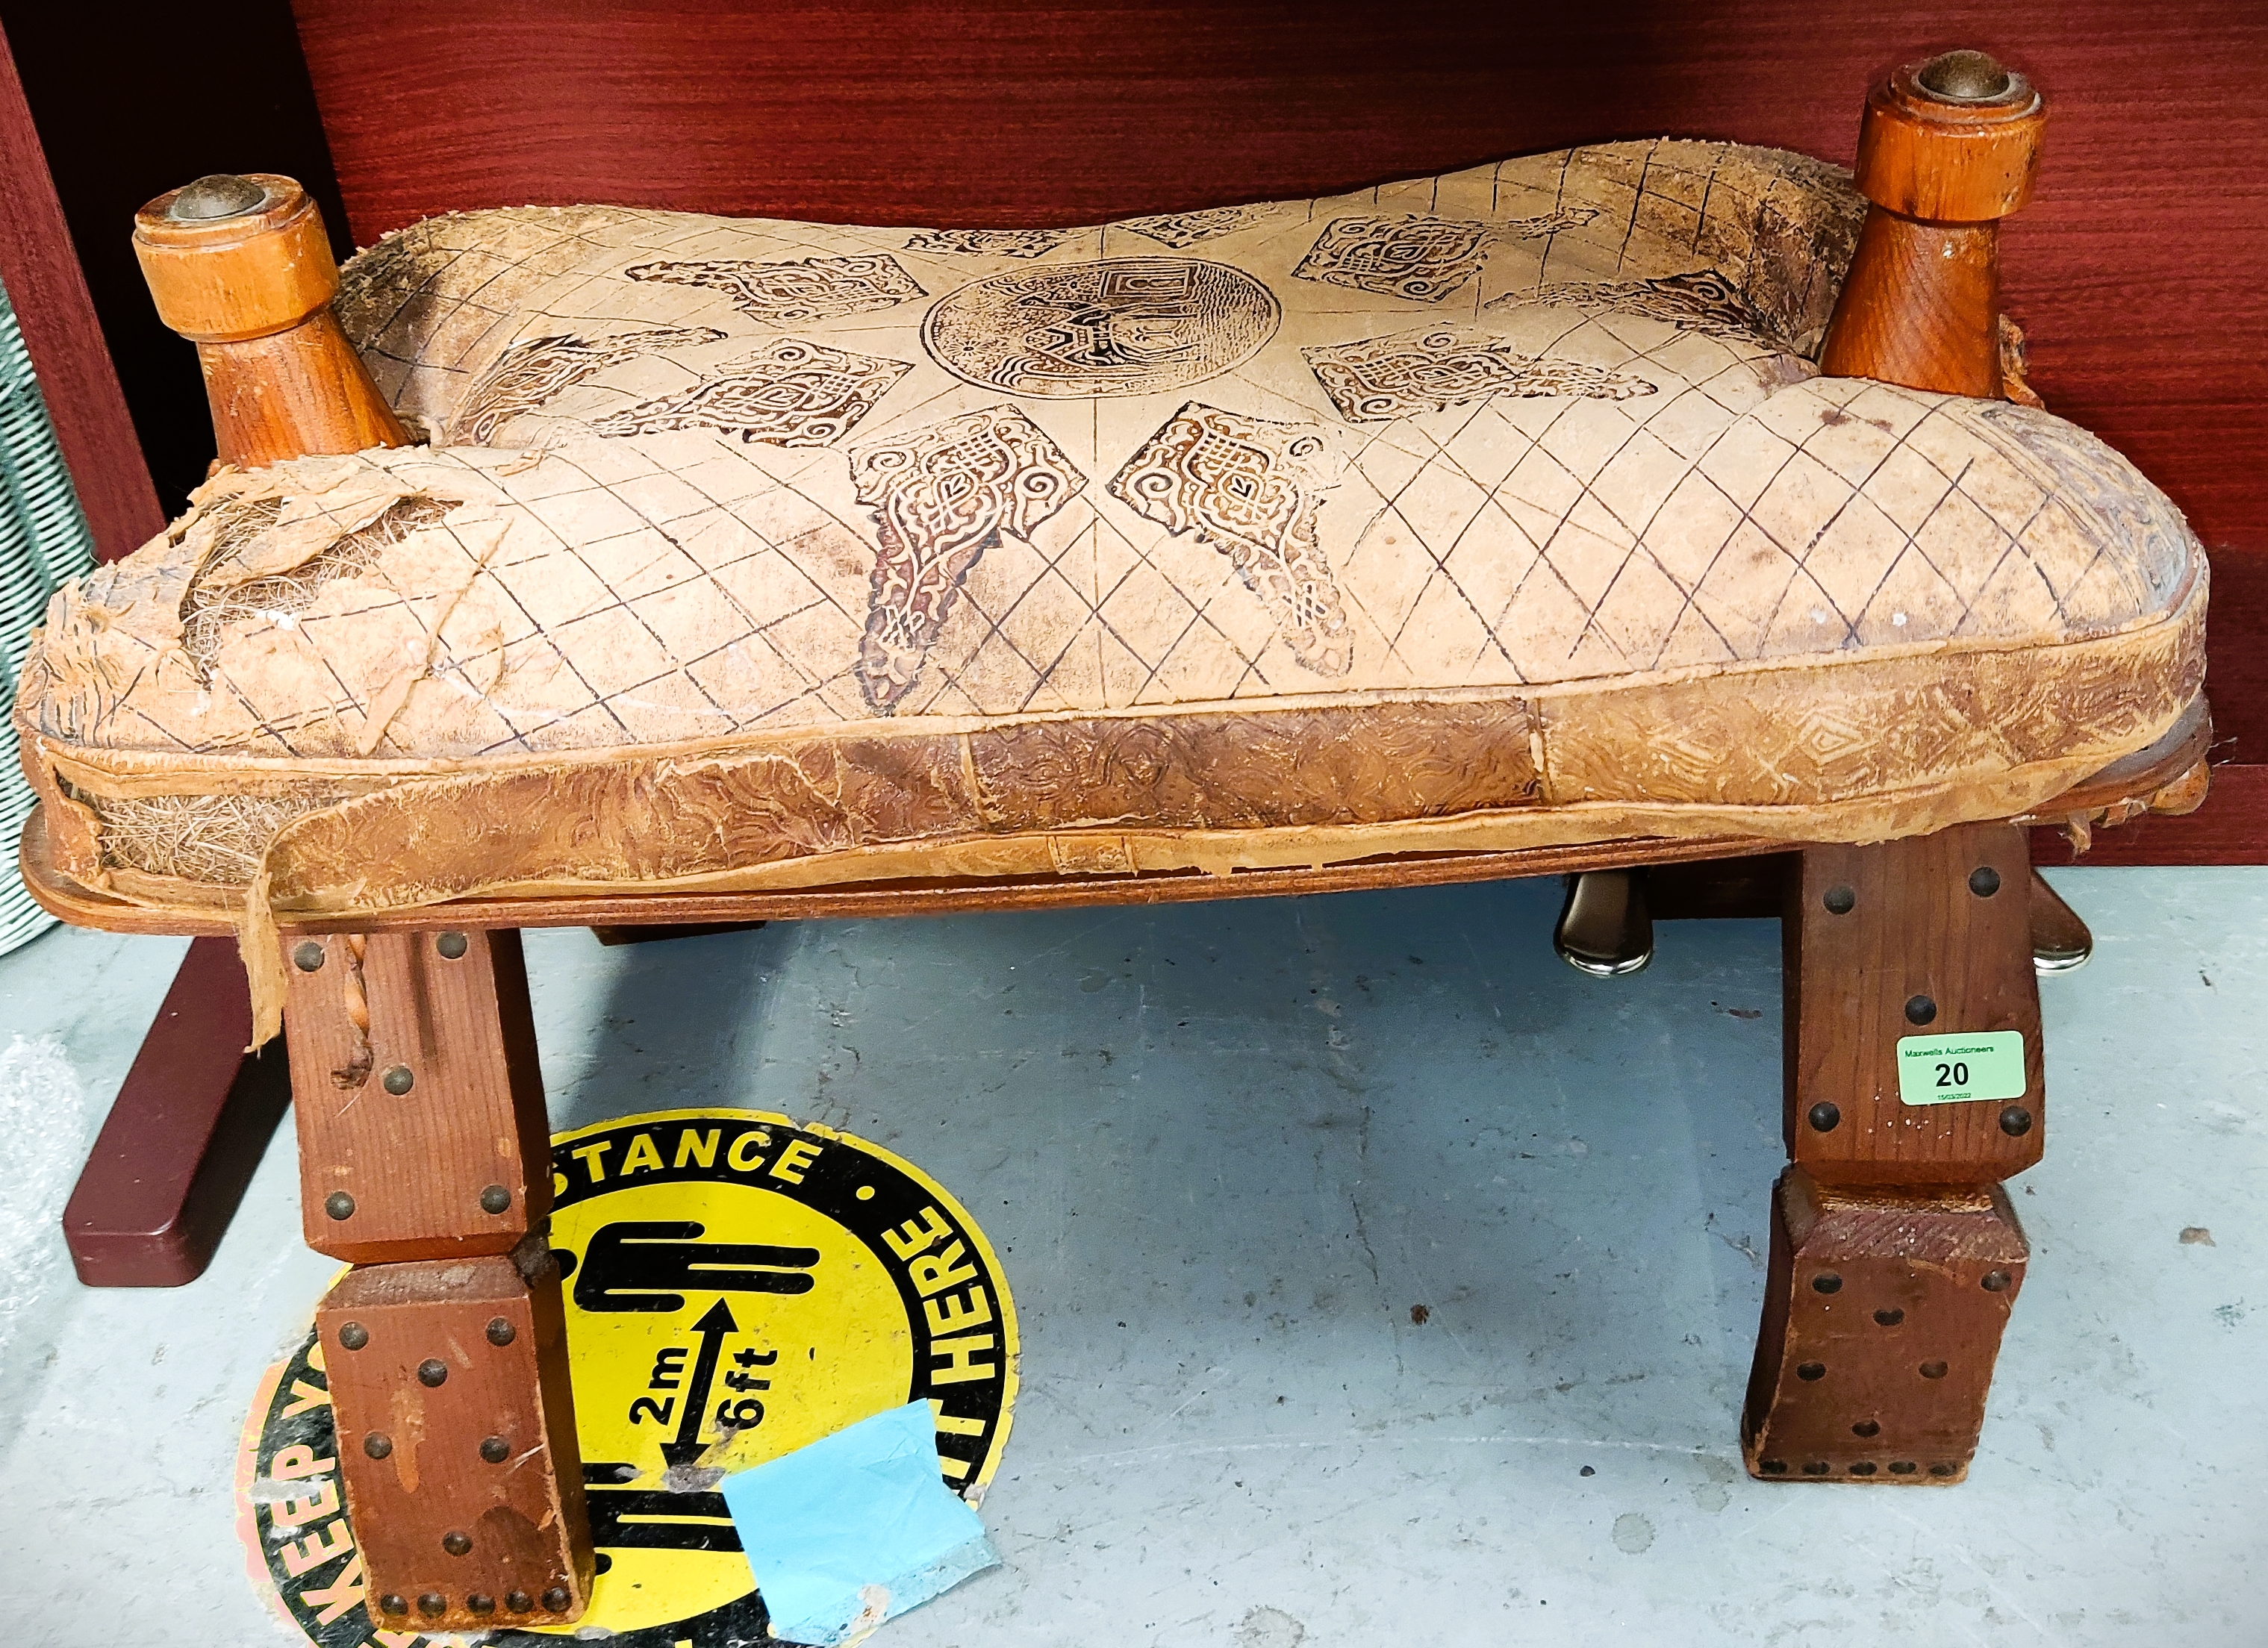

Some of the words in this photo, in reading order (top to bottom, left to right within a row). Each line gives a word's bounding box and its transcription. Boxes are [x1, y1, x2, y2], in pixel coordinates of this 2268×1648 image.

[1904, 1048, 1943, 1058] Maxwells
[1945, 1046, 1994, 1055] Auctioneers
[1935, 1062, 1969, 1087] 20
[1937, 1093, 1971, 1101] 15/03/2022
[881, 1205, 996, 1385] HERE
[629, 1348, 688, 1426] 2m
[715, 1348, 778, 1431] 6ft
[271, 1444, 365, 1626] KEEP
